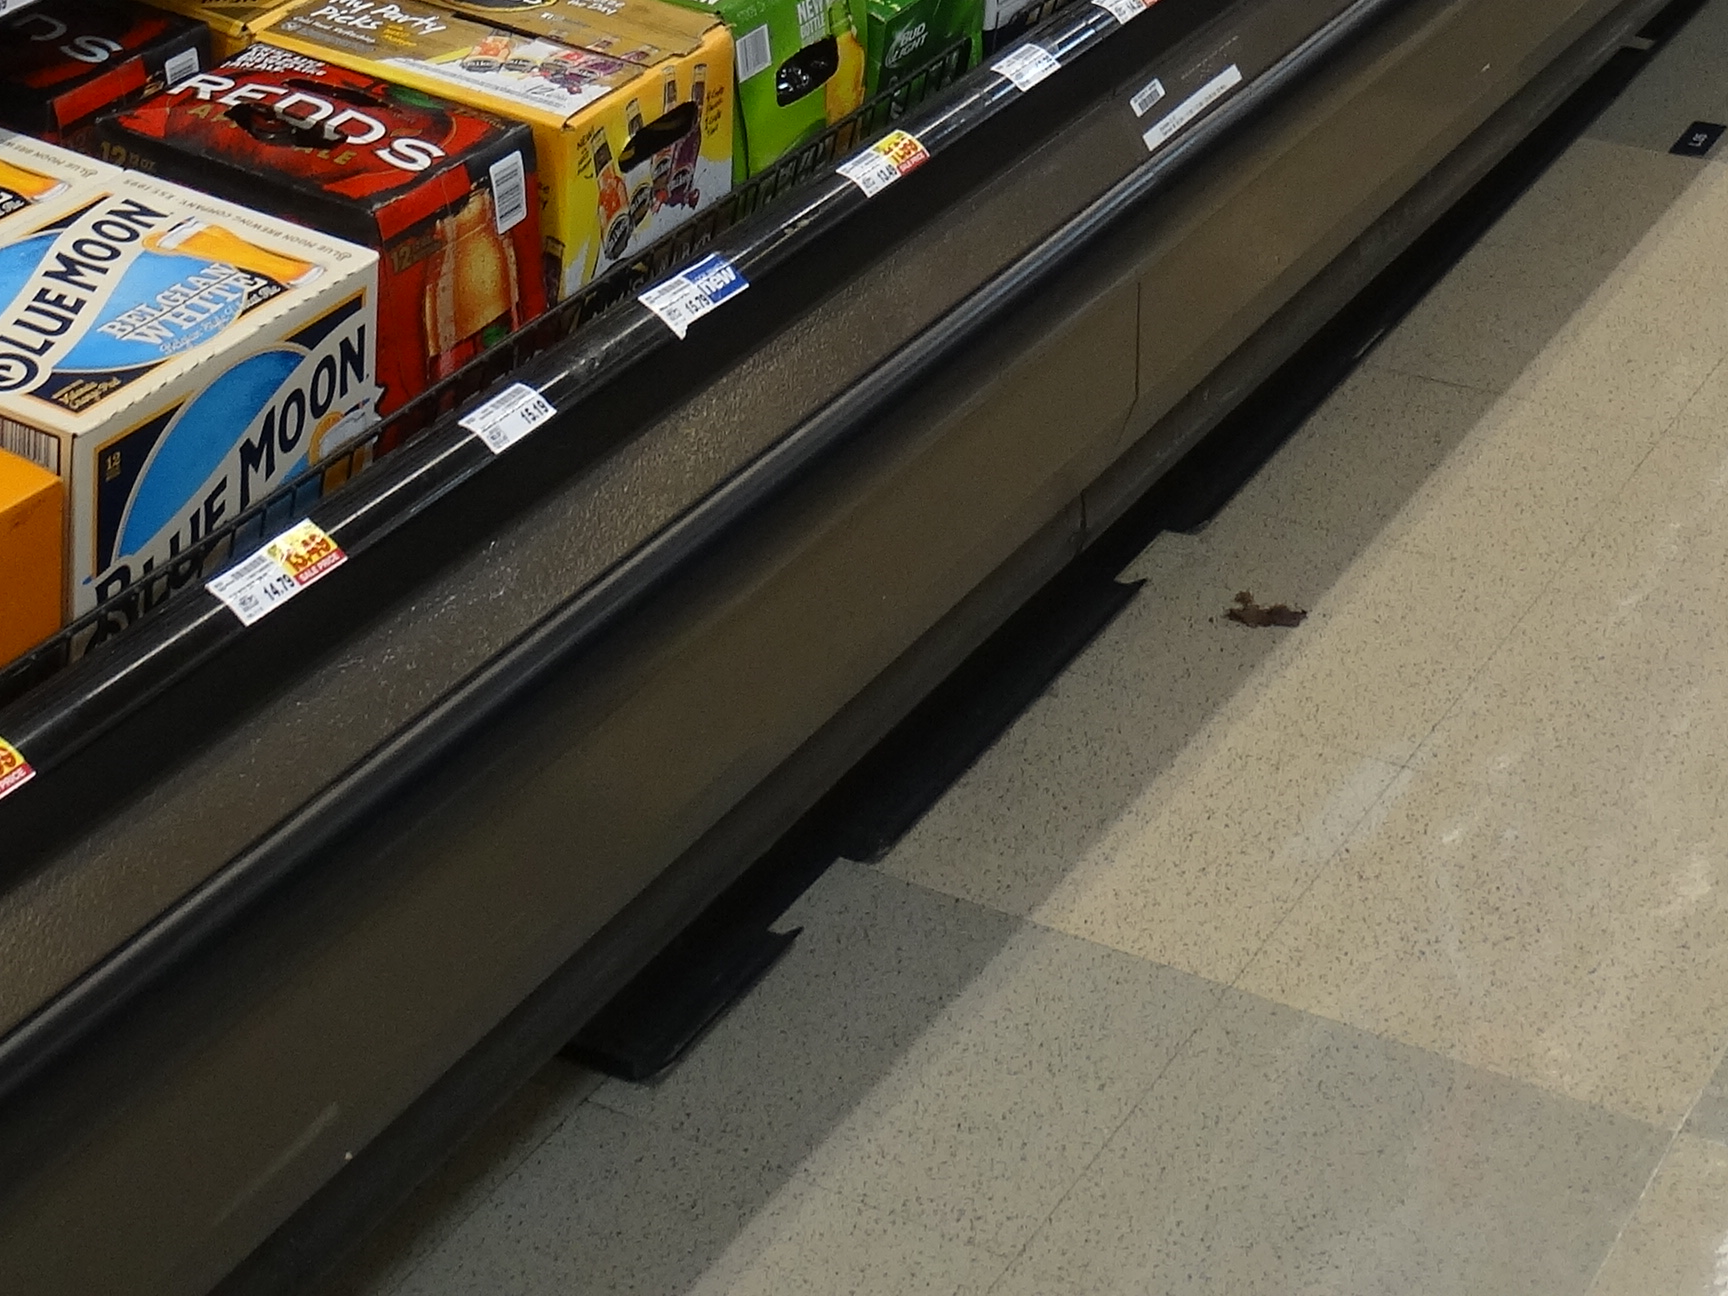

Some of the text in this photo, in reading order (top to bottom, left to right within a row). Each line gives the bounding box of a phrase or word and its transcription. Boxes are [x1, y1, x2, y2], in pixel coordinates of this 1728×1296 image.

[60, 199, 167, 292] MOON
[520, 401, 551, 425] 15.19
[262, 574, 297, 604] 14.79
